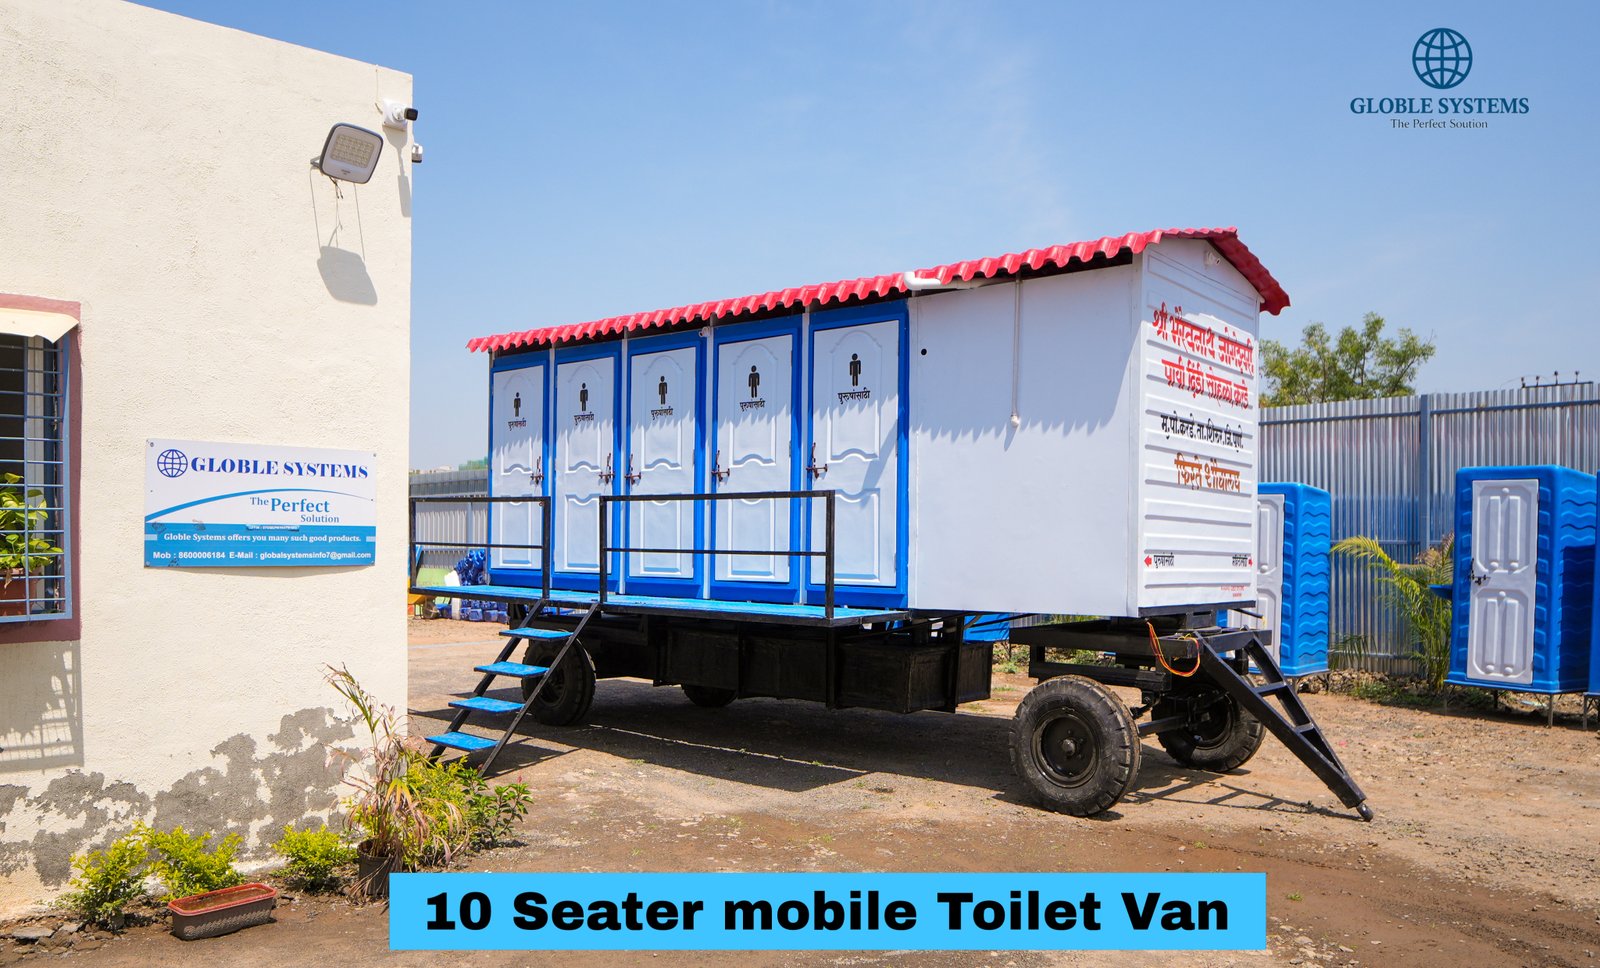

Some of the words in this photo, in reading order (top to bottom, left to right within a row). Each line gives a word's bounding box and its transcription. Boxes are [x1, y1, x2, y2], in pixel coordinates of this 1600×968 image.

[1152, 302, 1168, 341] श्री
[191, 456, 279, 475] GLOBLE
[283, 462, 368, 479] SYSTEMS
[1174, 452, 1203, 490] फिरते
[1204, 457, 1241, 493] शौचालय
[250, 497, 269, 506] The
[271, 498, 330, 513] Perfect
[300, 514, 340, 523] Solution
[164, 533, 191, 541] Globle
[192, 533, 226, 542] Systems
[227, 533, 251, 541] offers
[252, 535, 267, 543] you
[268, 535, 290, 543] many
[291, 534, 308, 542] such
[309, 534, 327, 544] good
[328, 534, 362, 544] products.
[153, 551, 171, 559] Mob
[178, 551, 226, 559] 8600006184
[229, 551, 254, 559] E-Mail
[259, 551, 372, 561] globalsystemsinfo7@gmail.com
